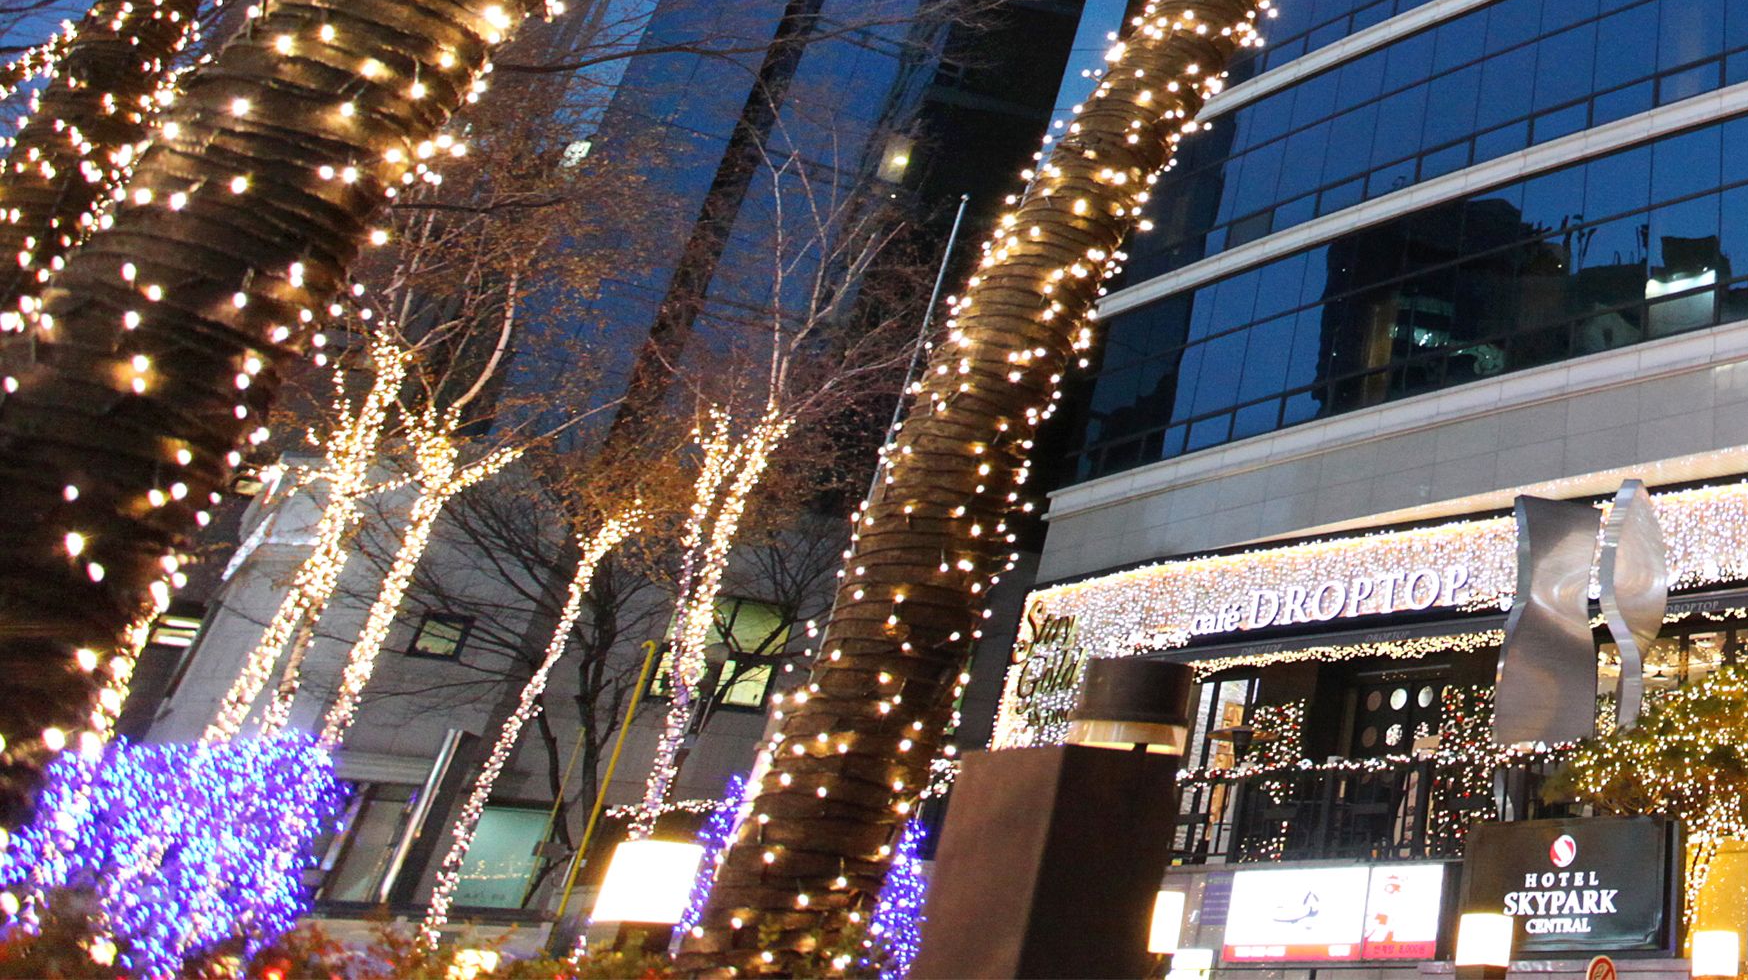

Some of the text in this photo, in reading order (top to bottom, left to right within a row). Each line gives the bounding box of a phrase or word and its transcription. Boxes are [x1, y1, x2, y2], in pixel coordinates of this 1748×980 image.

[1190, 564, 1470, 636] café DROPTOP
[1666, 601, 1719, 614] DROPTOP
[1011, 600, 1076, 664] Stay
[1365, 630, 1411, 642] DROPTOP
[1241, 644, 1282, 656] DROPTOP
[1016, 648, 1084, 714] Gold
[1525, 871, 1599, 888] HOTEL
[1503, 889, 1618, 915] SKYPARK
[1525, 917, 1592, 934] CENTRAL
